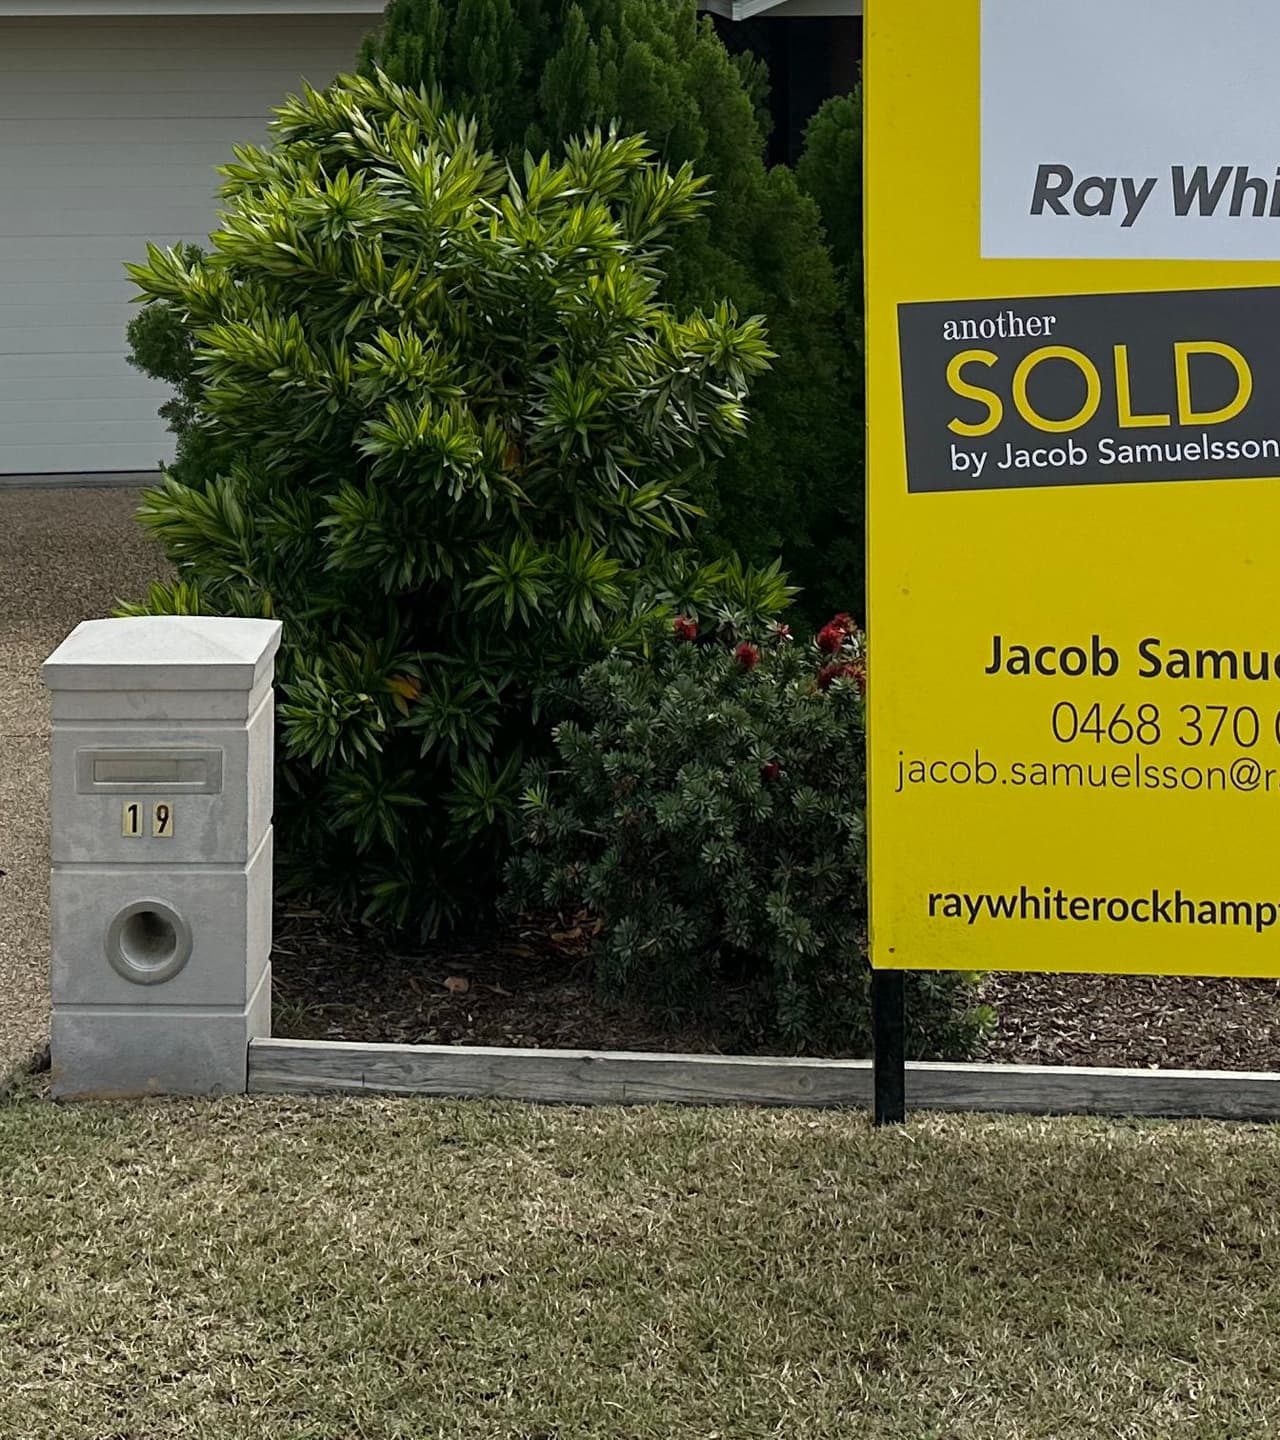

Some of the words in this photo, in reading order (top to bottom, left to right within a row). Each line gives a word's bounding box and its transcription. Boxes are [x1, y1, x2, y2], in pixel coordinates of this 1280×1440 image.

[1028, 164, 1158, 228] Ray
[943, 310, 1057, 342] another
[945, 341, 1254, 437] SOLD
[950, 444, 988, 478] by
[997, 438, 1088, 469] Jacob
[1098, 433, 1280, 465] Samuelsson
[984, 634, 1120, 678] Jacob
[1052, 701, 1161, 746] 0468
[1178, 704, 1260, 748] 370
[128, 804, 170, 834] 19
